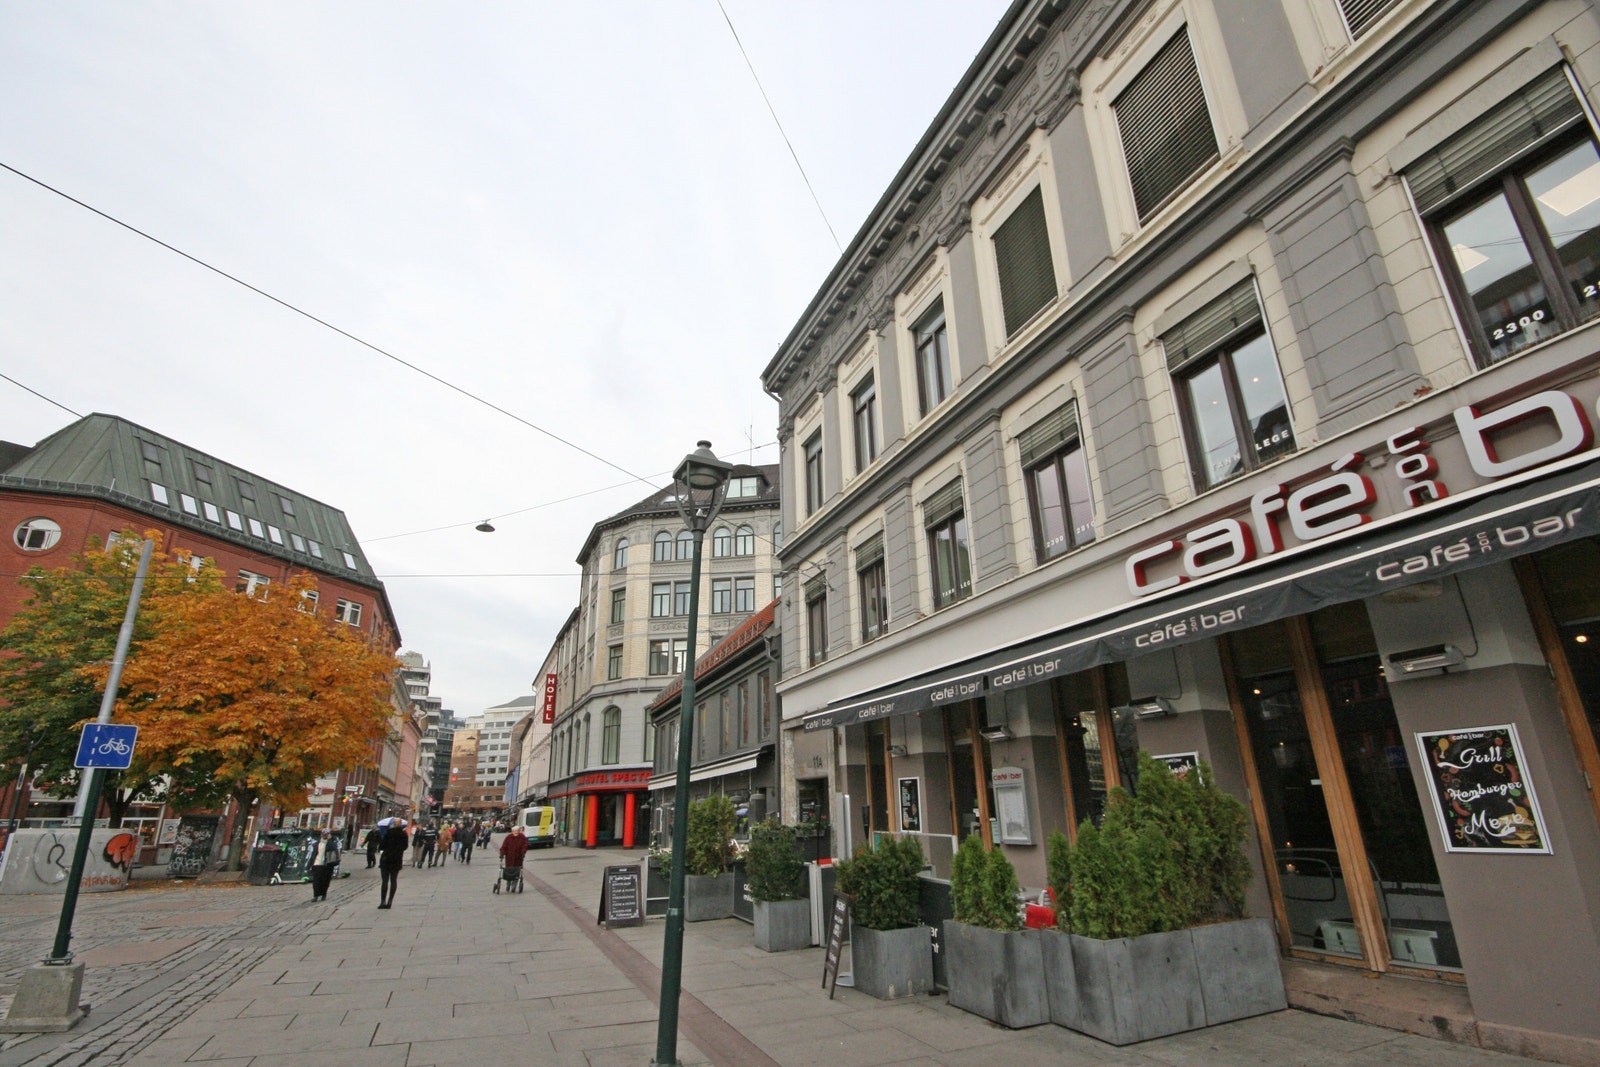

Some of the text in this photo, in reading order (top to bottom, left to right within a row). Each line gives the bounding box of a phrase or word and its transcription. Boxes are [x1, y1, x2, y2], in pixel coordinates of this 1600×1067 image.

[1493, 310, 1544, 340] 2300
[1255, 429, 1289, 451] LEGE
[1125, 453, 1376, 597] café
[1376, 536, 1471, 581] café
[1496, 507, 1582, 546] bar
[1135, 619, 1187, 648] café
[1200, 605, 1246, 629] bar
[993, 666, 1027, 687] café
[1033, 659, 1061, 676] bar
[545, 677, 555, 720] HOTEL
[930, 686, 955, 701] café
[959, 681, 981, 695] bar
[858, 704, 877, 718] café
[880, 702, 895, 713] bar
[805, 719, 819, 729] café
[821, 718, 833, 726] bar
[1437, 745, 1502, 770] Grill
[585, 773, 608, 784] HOTEL
[1447, 782, 1522, 802] Hamburger
[1464, 809, 1525, 837] Meze
